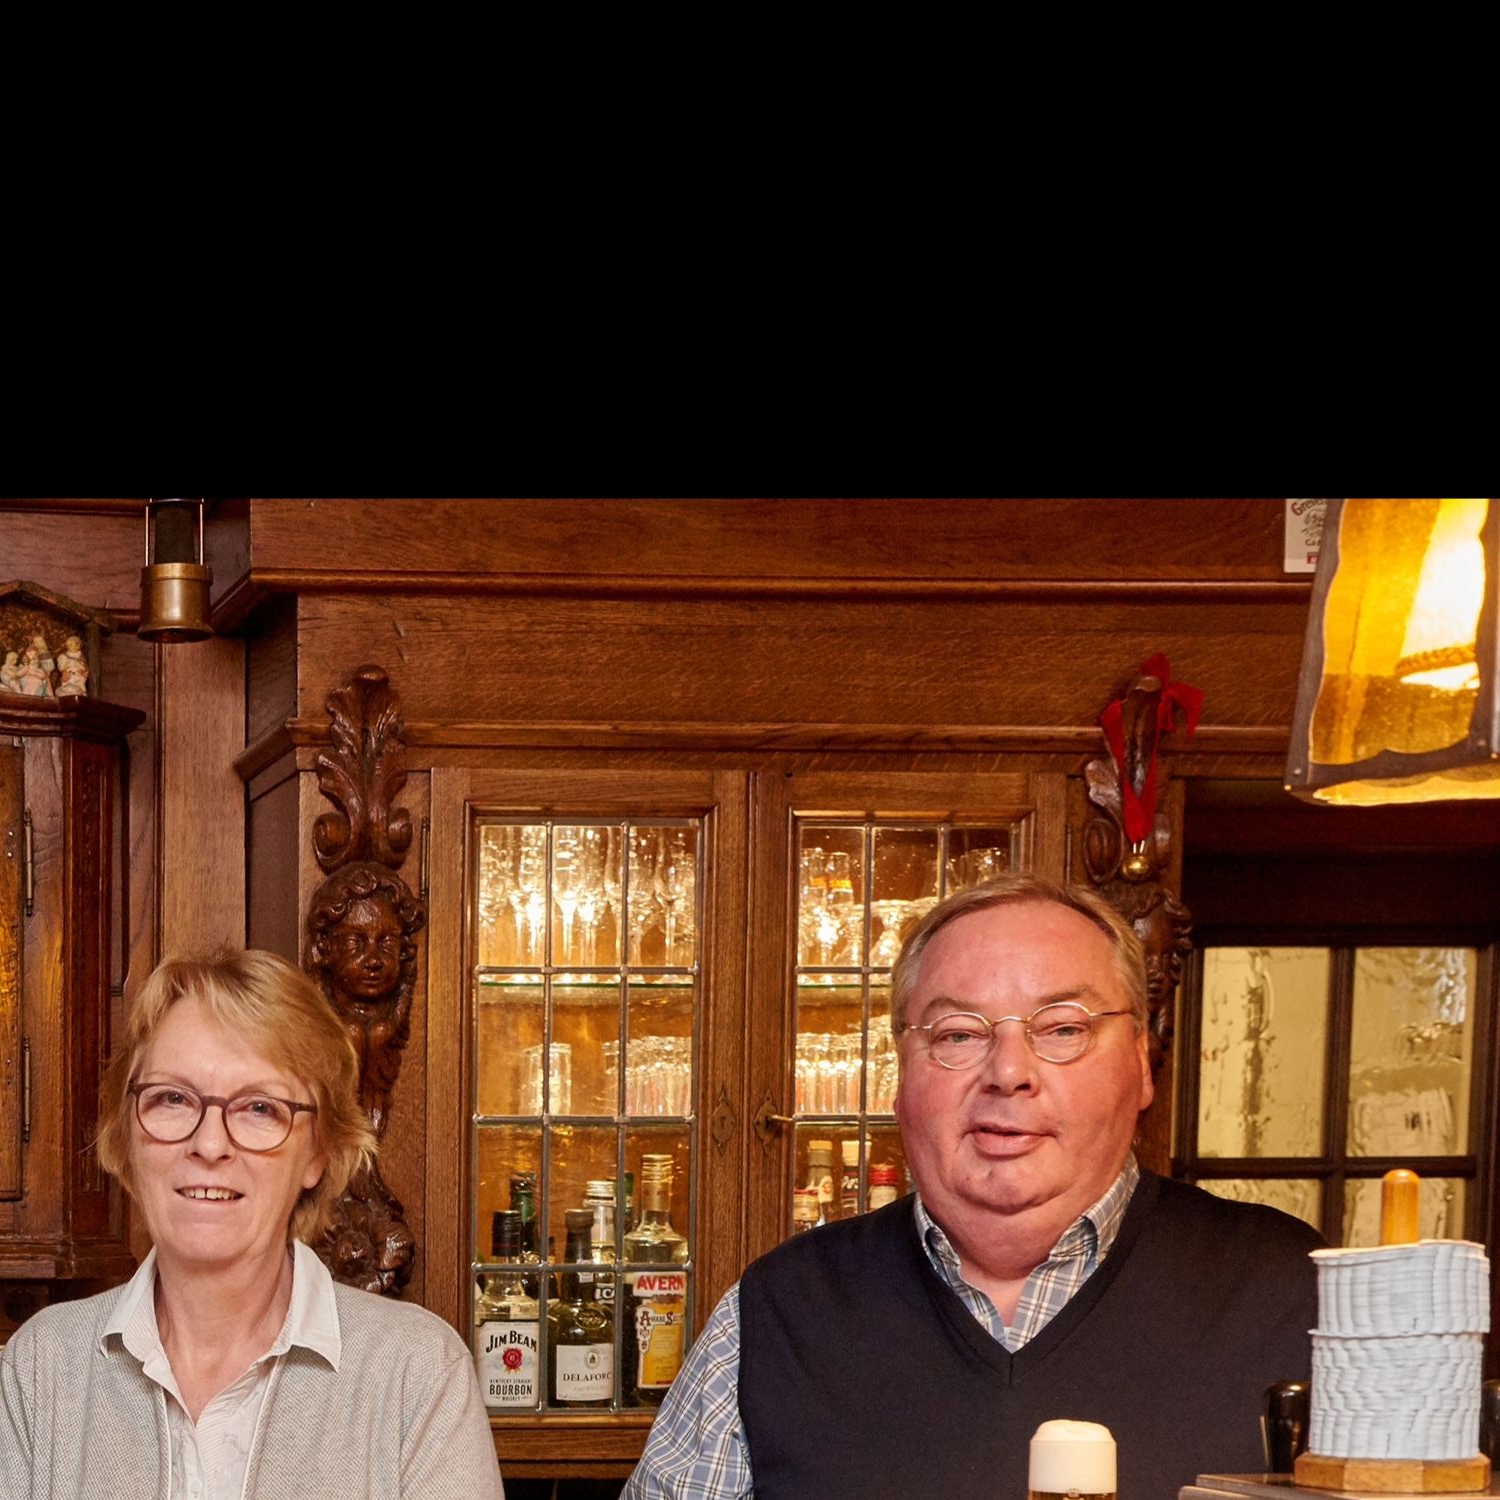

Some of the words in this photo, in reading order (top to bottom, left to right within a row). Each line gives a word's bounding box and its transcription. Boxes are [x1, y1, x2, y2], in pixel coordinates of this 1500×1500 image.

[637, 1275, 684, 1291] AVERN
[486, 1333, 507, 1353] JIM
[509, 1330, 537, 1352] BEAM
[563, 1371, 612, 1382] DELAFORC
[489, 1384, 532, 1396] BOURBON
